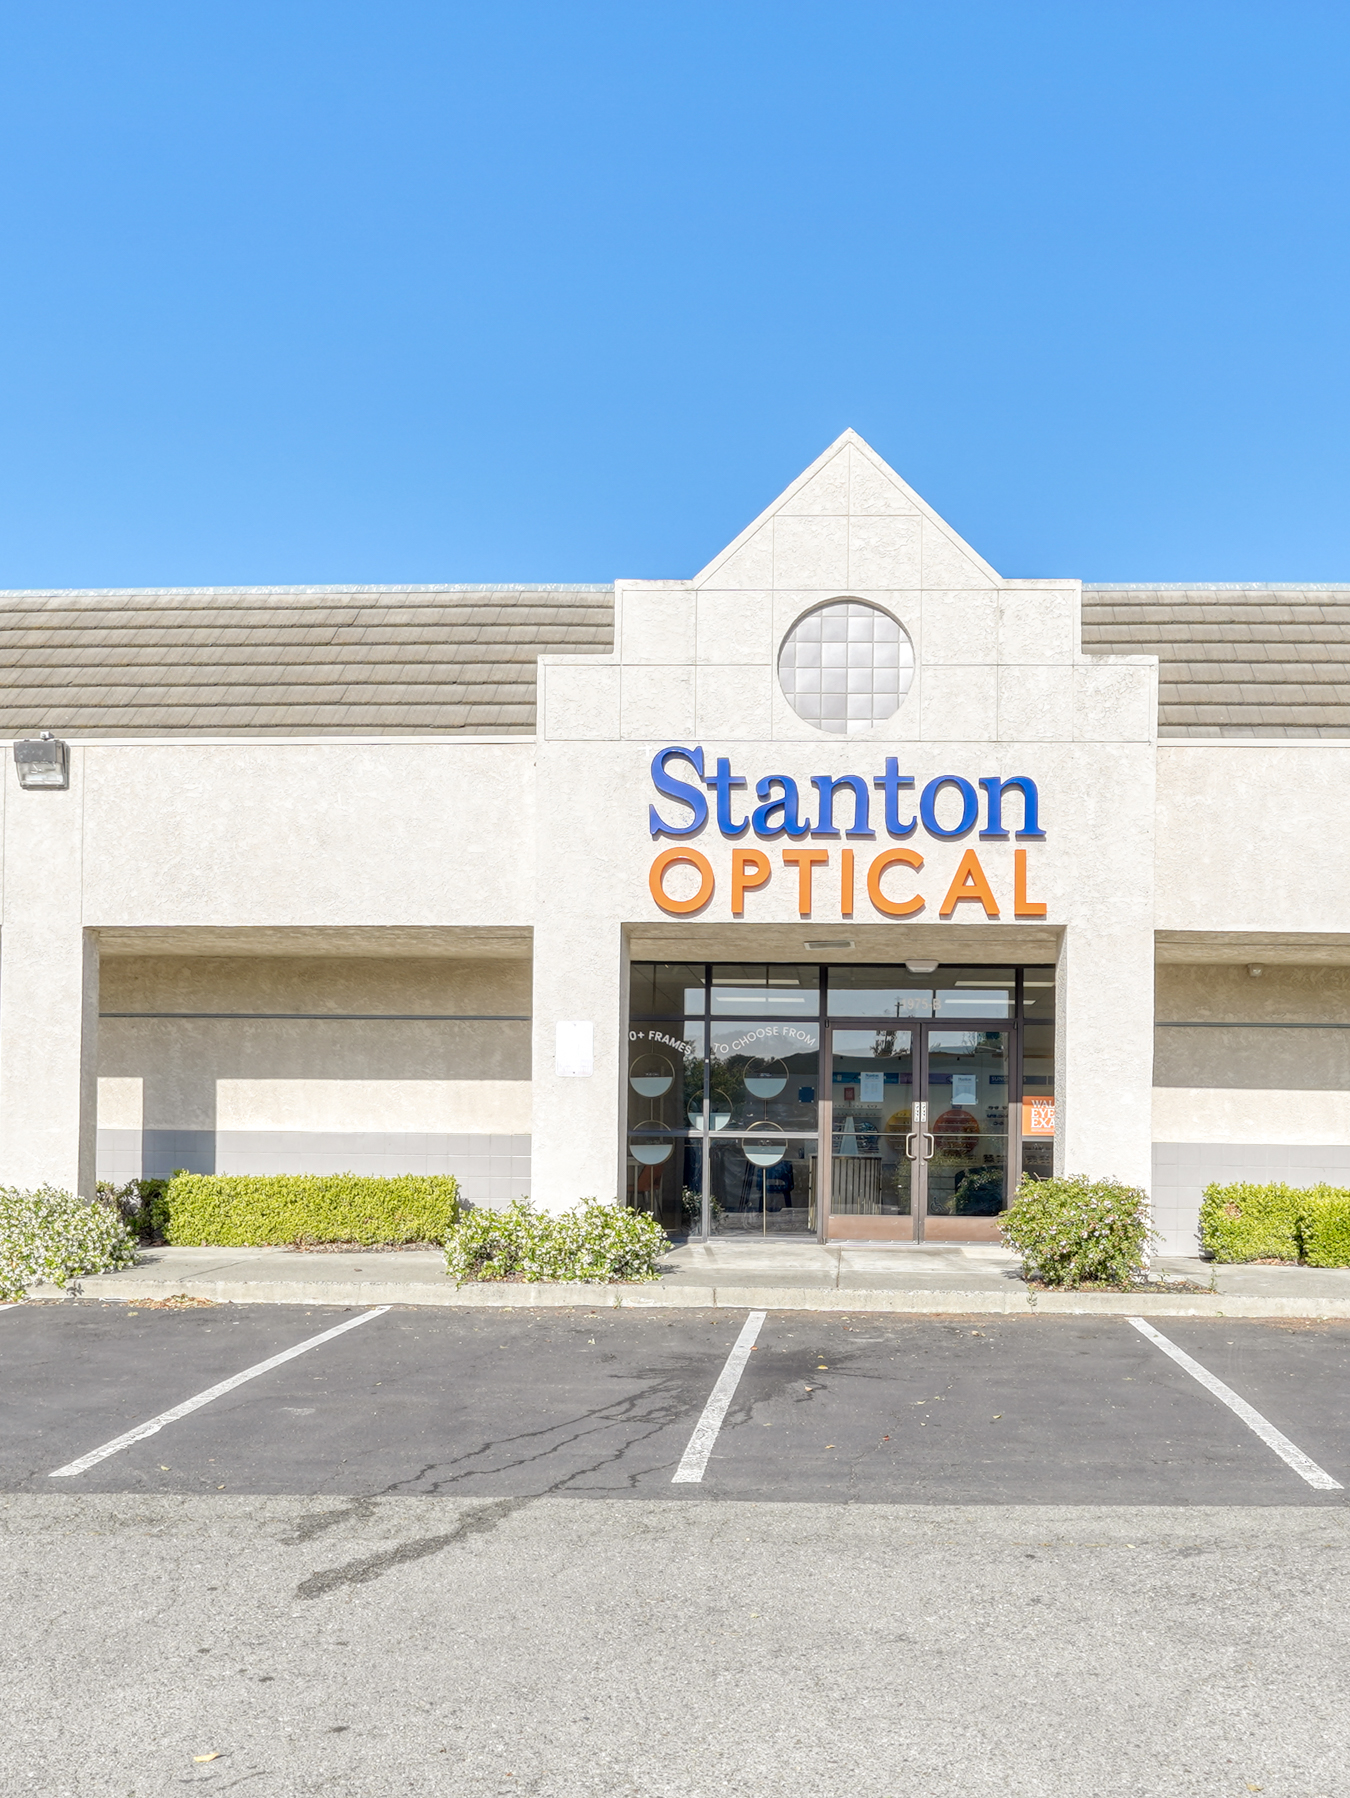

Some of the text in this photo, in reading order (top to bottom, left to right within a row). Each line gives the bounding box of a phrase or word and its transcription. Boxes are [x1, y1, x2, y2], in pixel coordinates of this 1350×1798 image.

[649, 745, 1047, 838] Stanton
[648, 846, 1048, 916] OPTICAL
[648, 1030, 692, 1055] FRAMES
[713, 1042, 729, 1054] TO
[732, 1026, 779, 1050] CHOOSE
[782, 1026, 817, 1046] FROM
[1031, 1108, 1055, 1118] EYE
